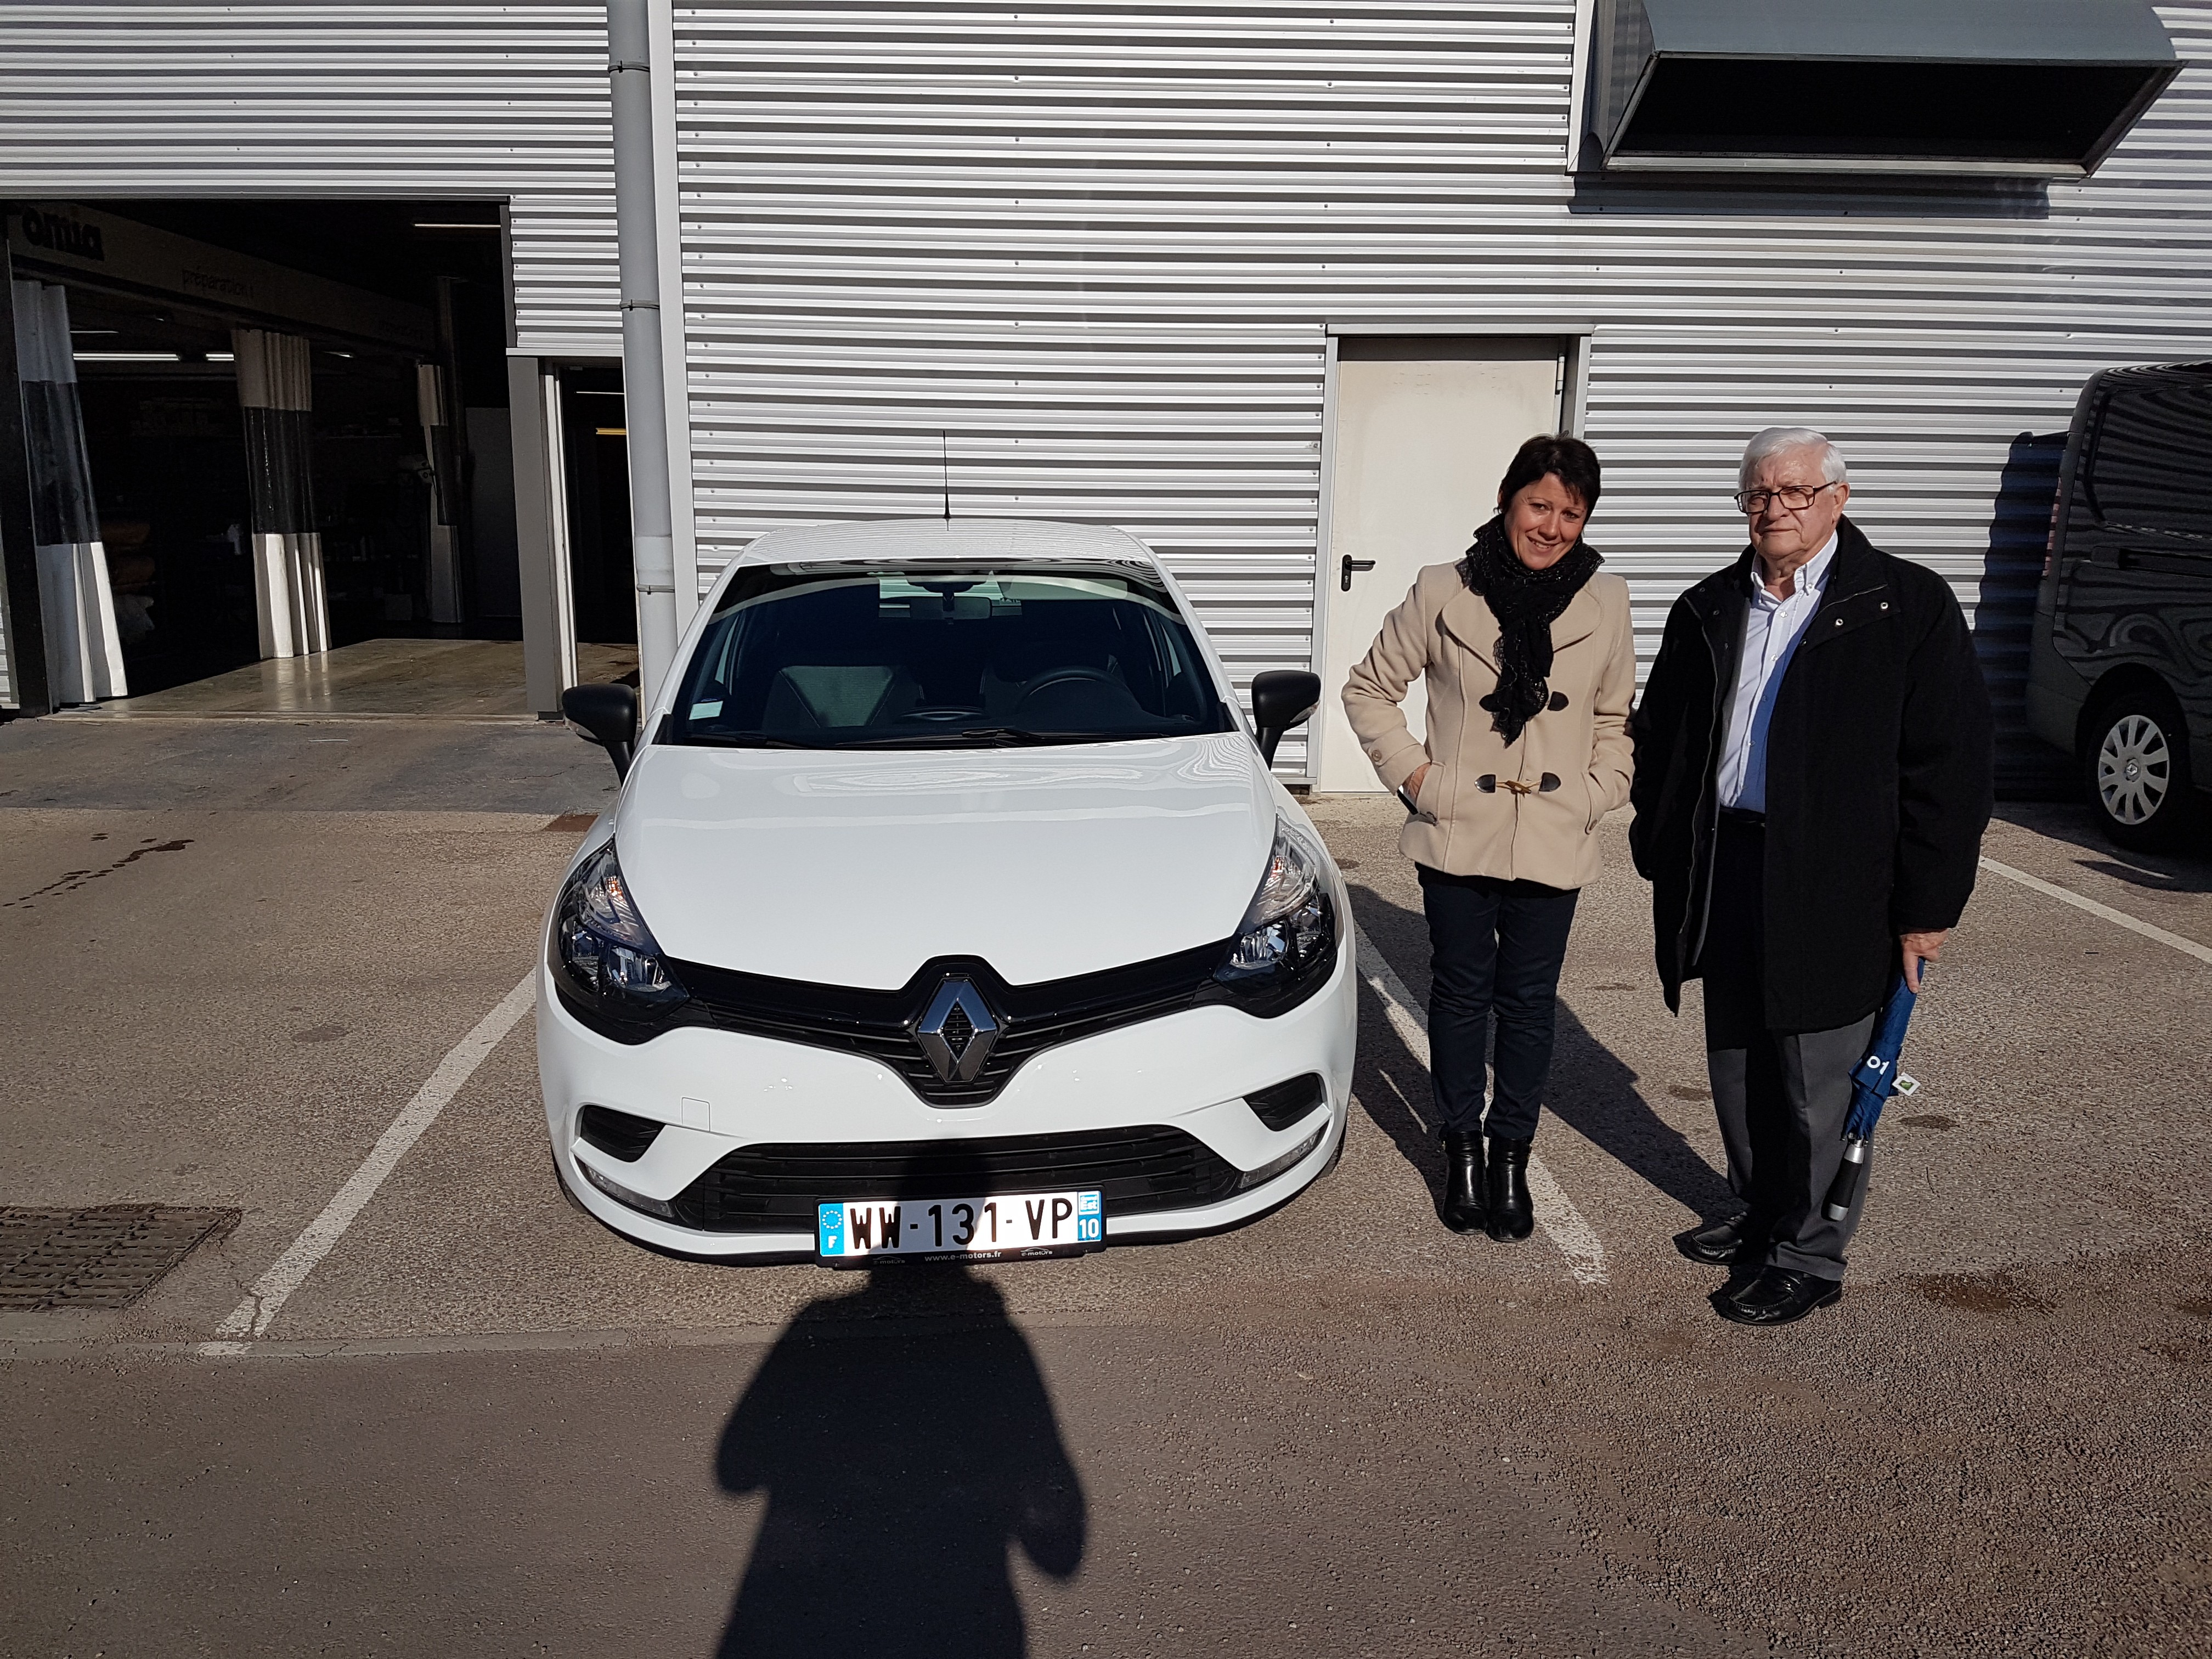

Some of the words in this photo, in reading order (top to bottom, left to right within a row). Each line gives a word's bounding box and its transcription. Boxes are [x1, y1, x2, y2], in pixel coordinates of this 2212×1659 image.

[1079, 1218, 1099, 1239] 10
[828, 1236, 837, 1248] F
[924, 1251, 1002, 1262] www.e-motors.fr
